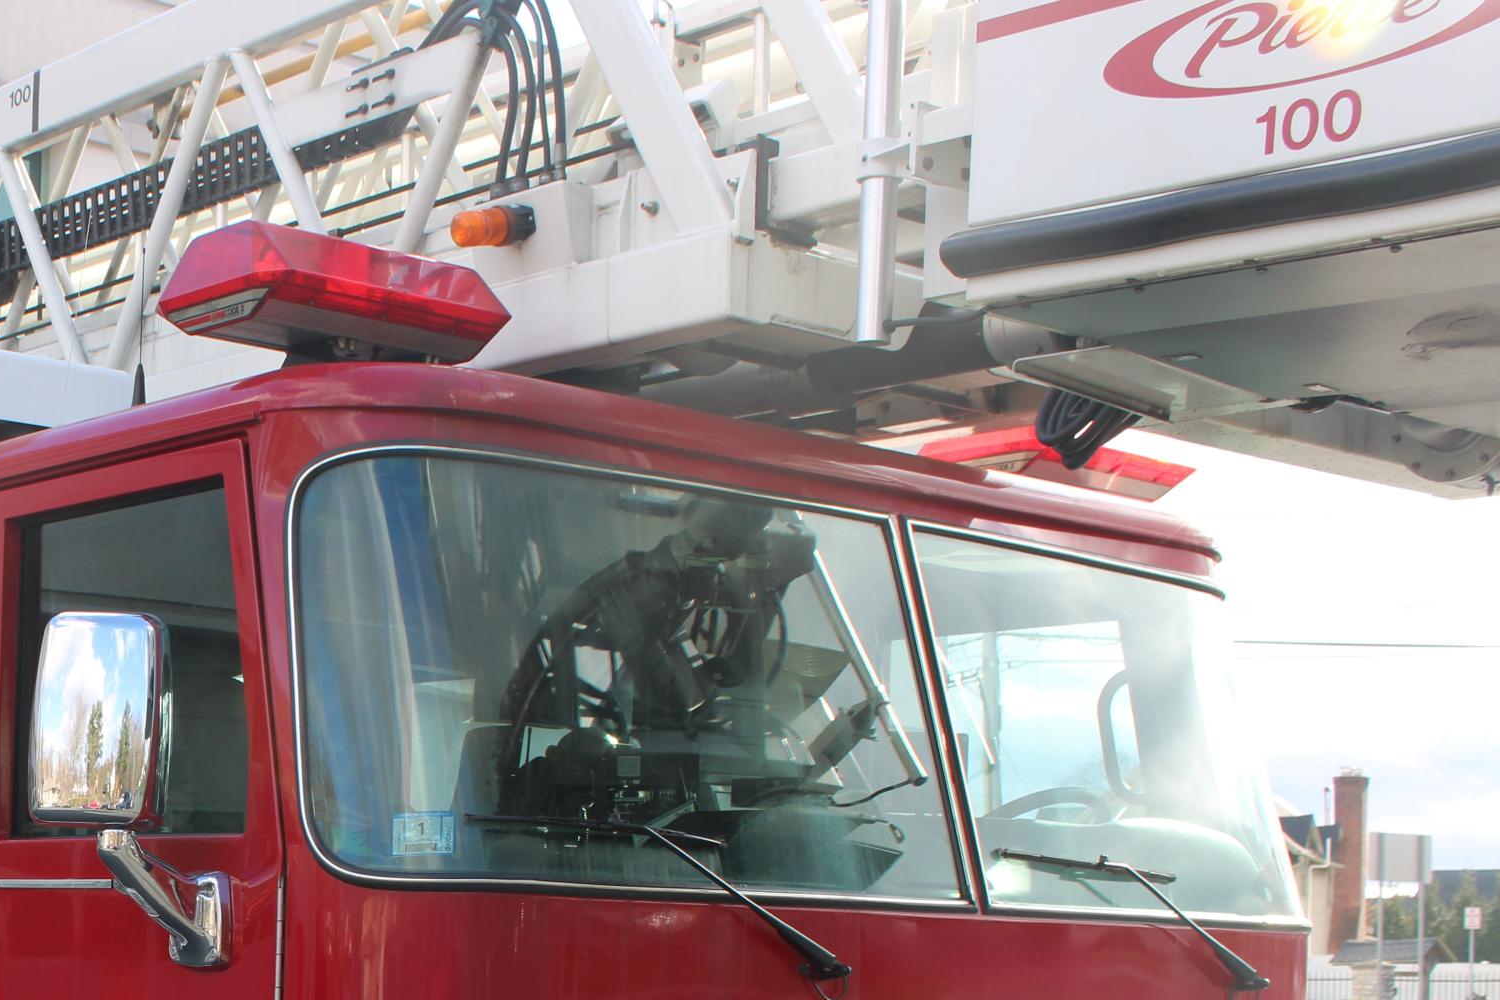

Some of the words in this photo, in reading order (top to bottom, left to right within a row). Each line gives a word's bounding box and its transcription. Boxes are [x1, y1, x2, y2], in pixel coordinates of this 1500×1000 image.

[1184, 0, 1440, 78] Piere
[9, 85, 31, 109] 100
[1255, 89, 1362, 155] 100
